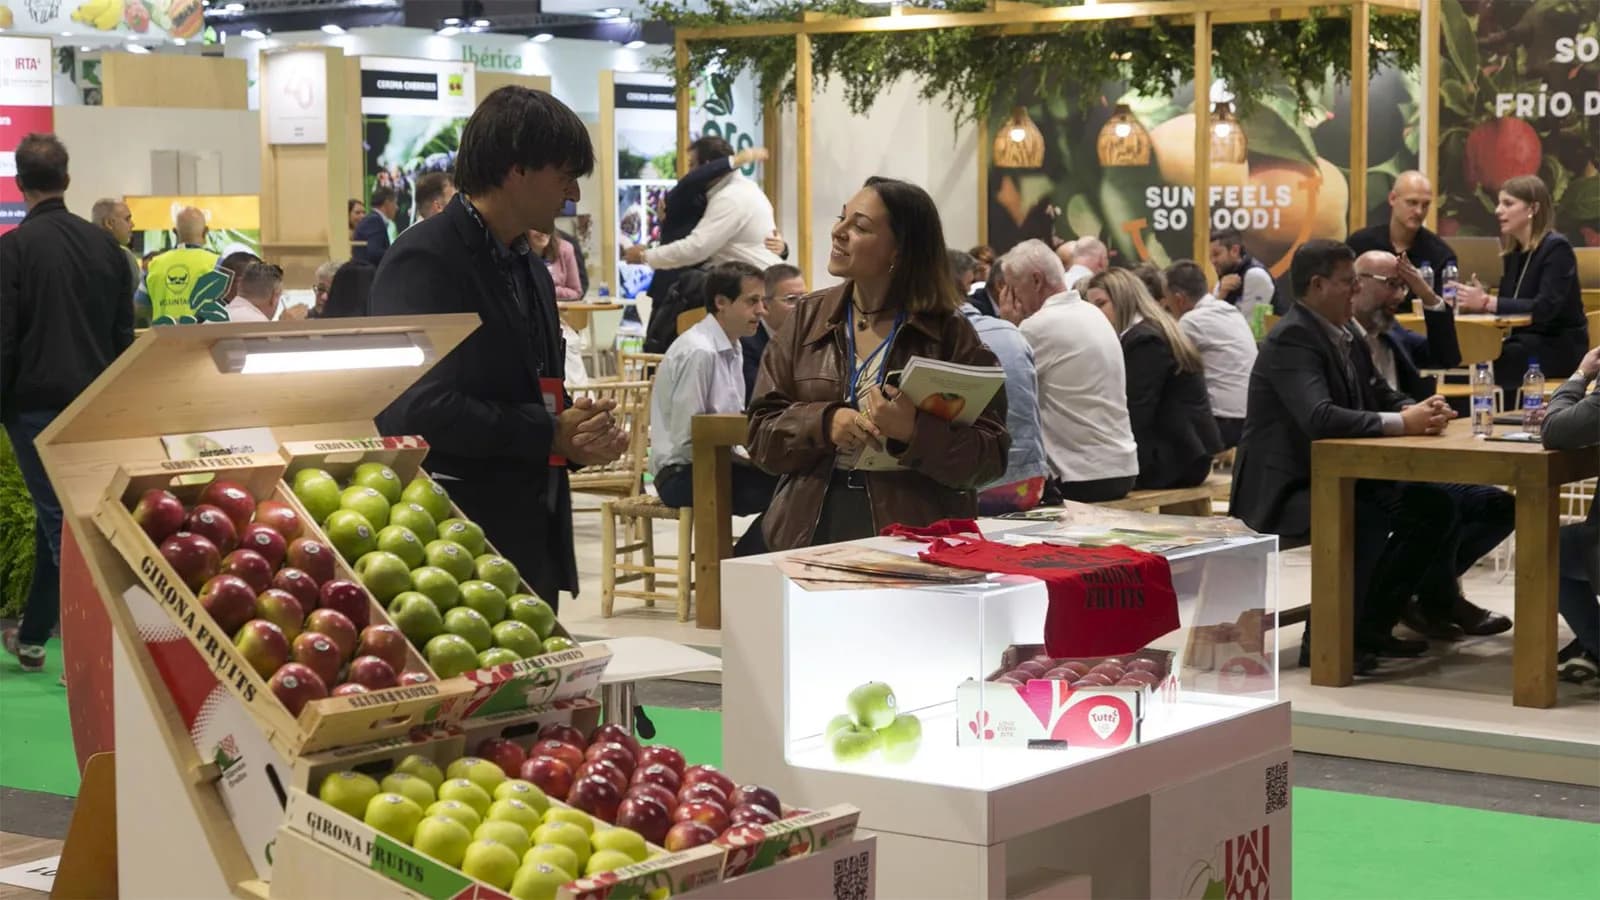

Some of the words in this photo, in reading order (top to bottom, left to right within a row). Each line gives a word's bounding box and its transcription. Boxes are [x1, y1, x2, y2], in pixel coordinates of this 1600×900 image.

[461, 44, 522, 69] Ibérica
[1496, 84, 1572, 117] FRÍO
[1146, 186, 1196, 208] SUN
[1209, 185, 1292, 207] FEELS
[1153, 208, 1188, 230] SO
[1207, 208, 1280, 230] OOD!
[1086, 587, 1145, 609] FRUITS
[141, 555, 196, 630] GIRONA
[196, 624, 257, 702] FRUITS
[306, 811, 361, 852] GIRONA
[366, 840, 424, 883] FRUITS
